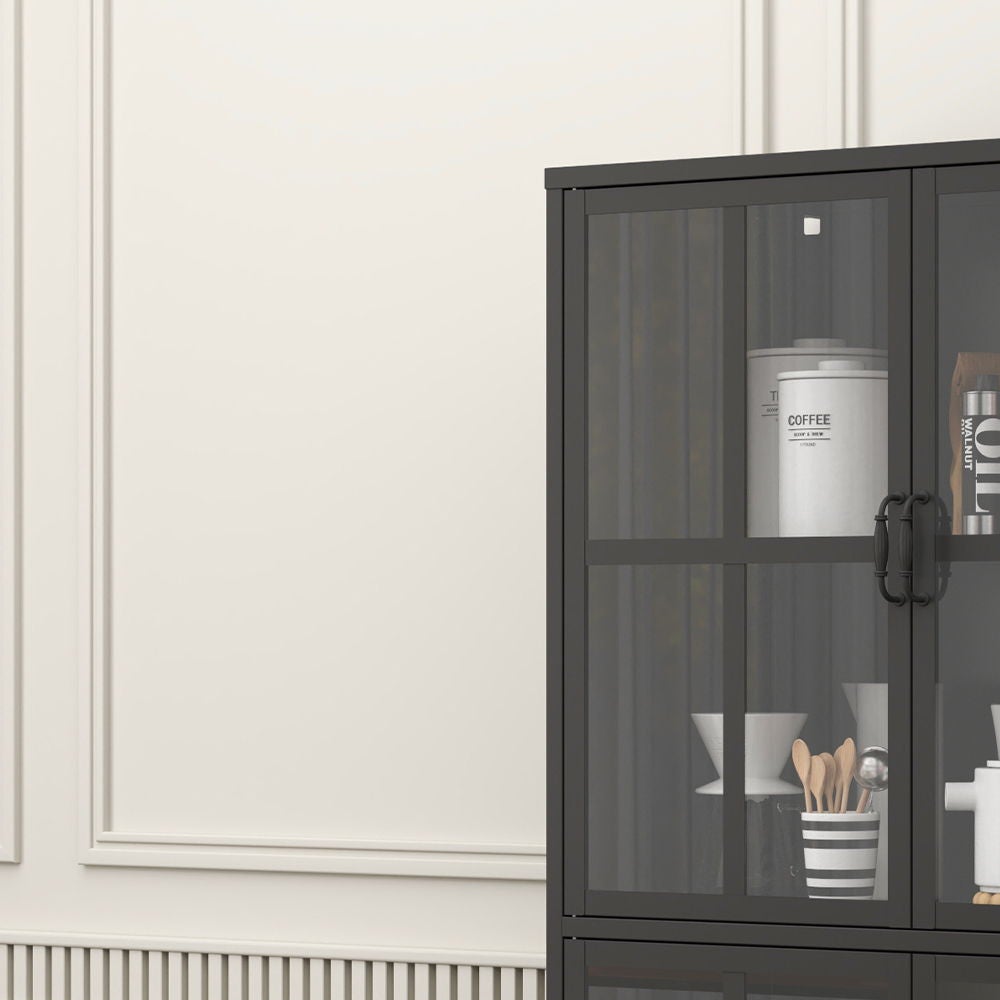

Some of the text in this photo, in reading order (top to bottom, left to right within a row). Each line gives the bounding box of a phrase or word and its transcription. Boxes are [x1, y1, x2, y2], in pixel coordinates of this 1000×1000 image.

[769, 390, 779, 401] T
[788, 414, 831, 426] COFFEE
[964, 418, 973, 471] WALNUT
